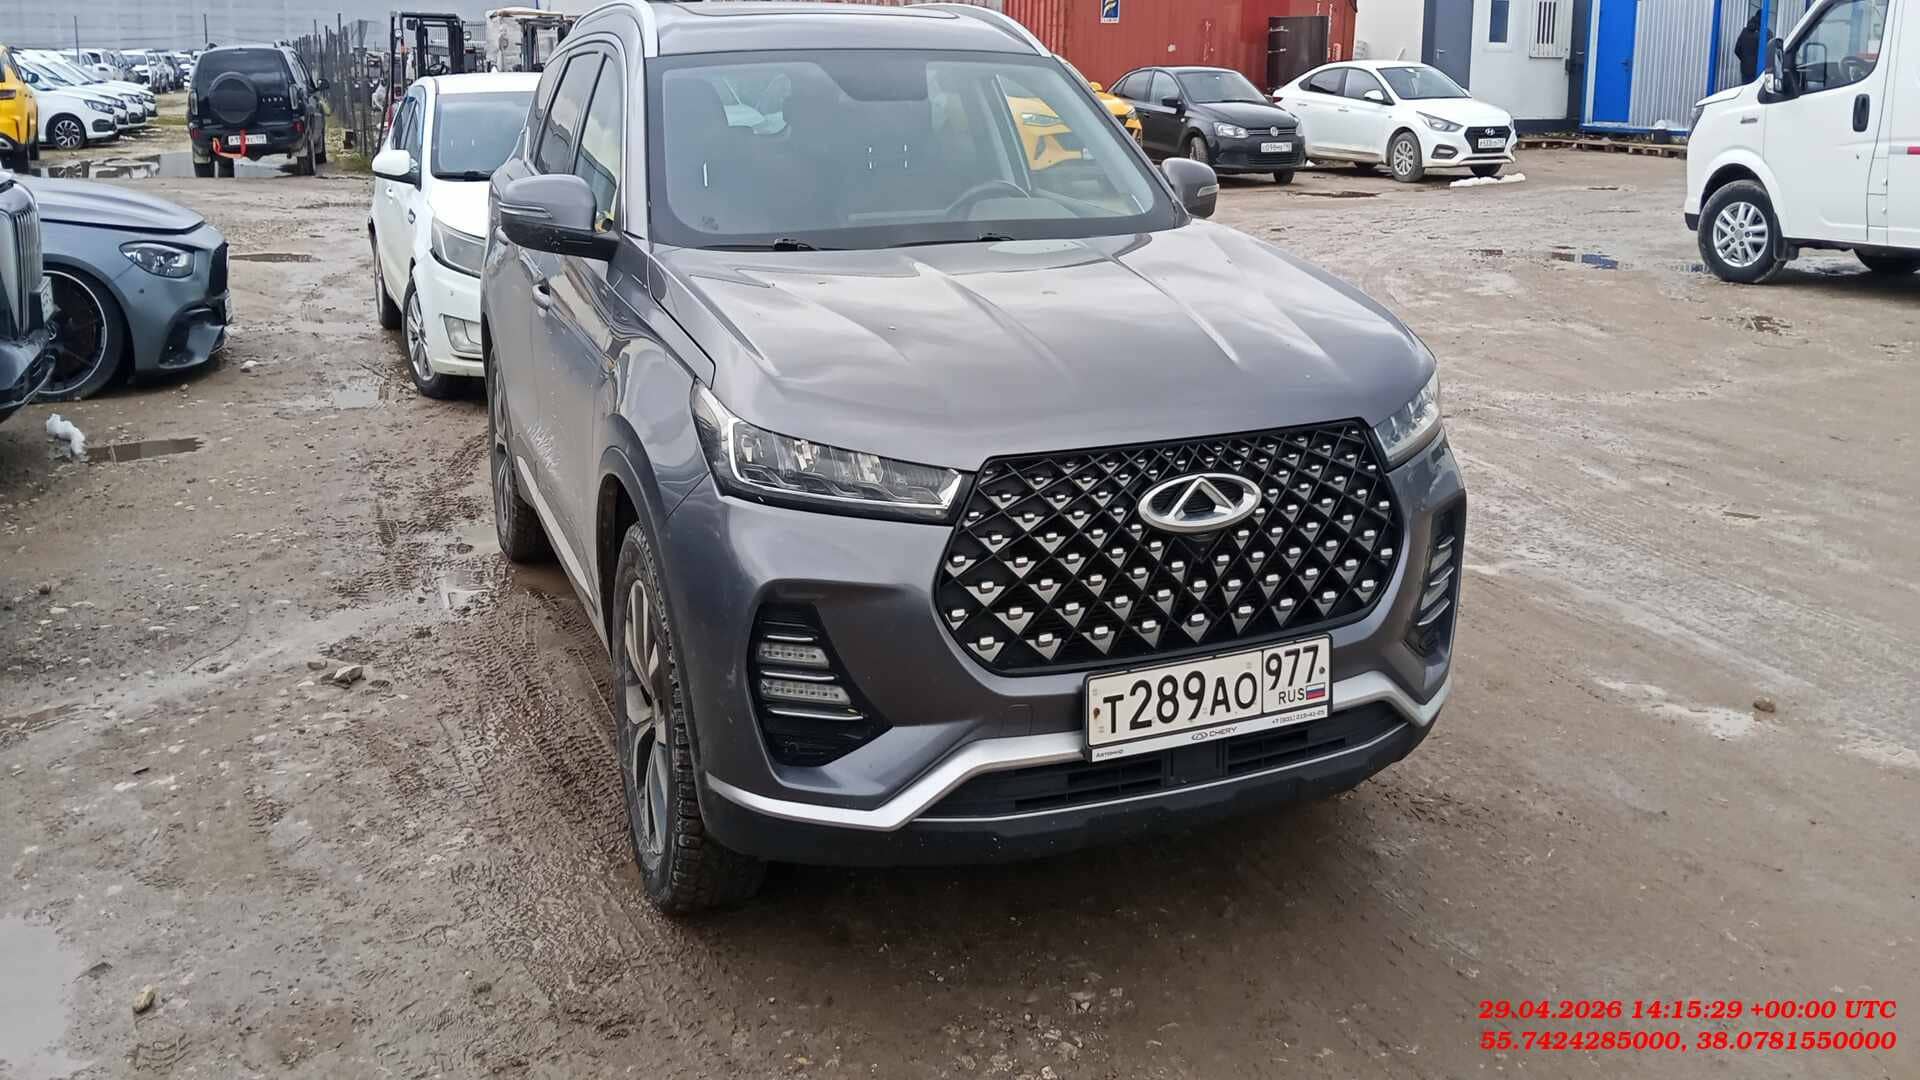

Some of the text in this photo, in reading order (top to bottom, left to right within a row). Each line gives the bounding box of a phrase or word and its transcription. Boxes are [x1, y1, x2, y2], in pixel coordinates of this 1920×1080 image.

[1103, 645, 1319, 734] Т289АО 977
[1278, 687, 1305, 705] RUS
[1208, 726, 1238, 738] CHERY
